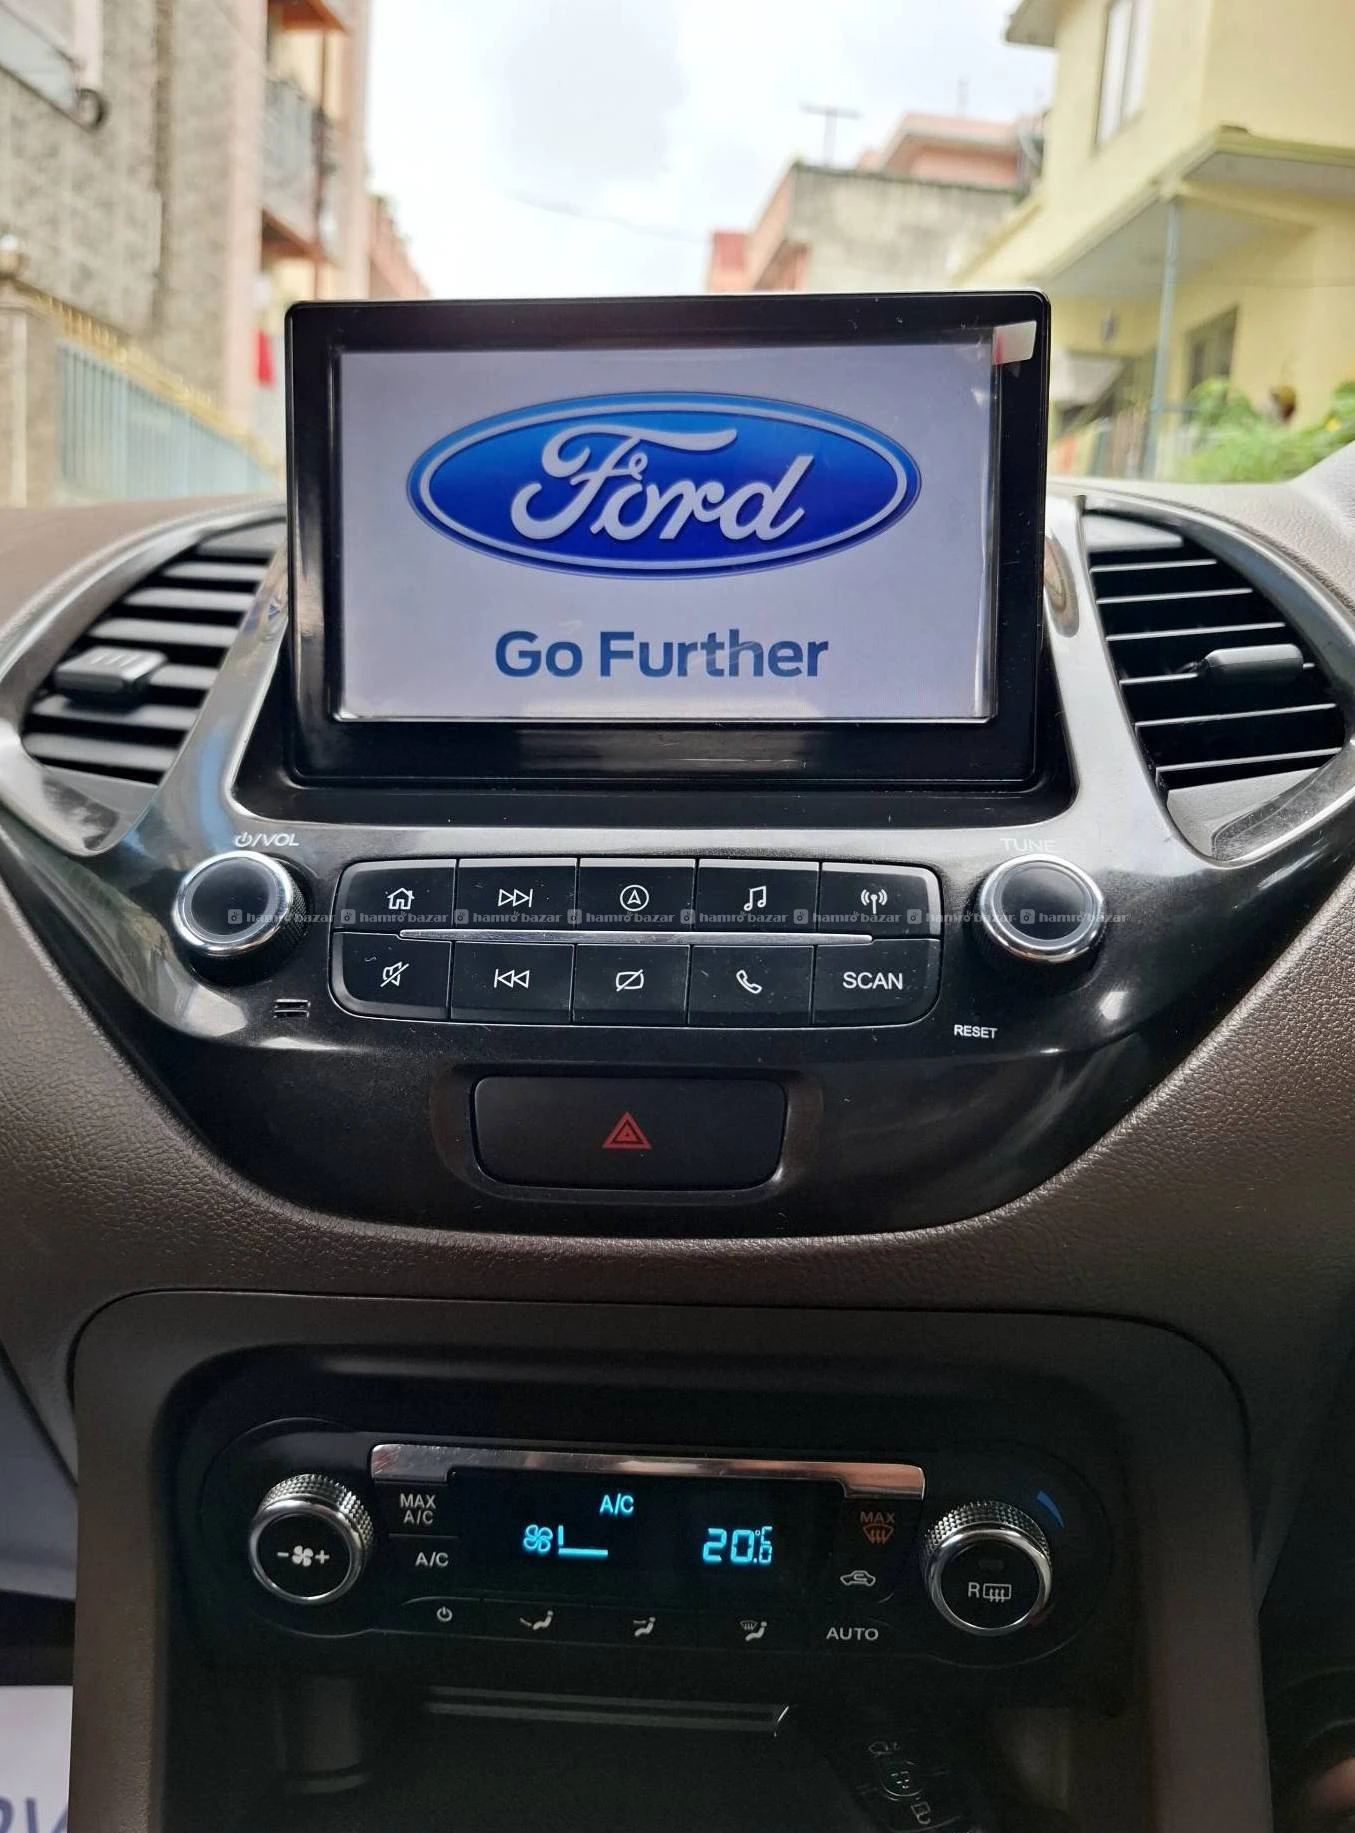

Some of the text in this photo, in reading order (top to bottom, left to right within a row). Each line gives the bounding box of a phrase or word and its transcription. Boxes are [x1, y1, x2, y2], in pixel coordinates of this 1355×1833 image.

[510, 423, 814, 542] Ford
[495, 628, 829, 678] Go Further
[1000, 838, 1057, 852] TUNE
[842, 972, 903, 990] SCAN
[953, 1024, 998, 1039] RESET
[400, 1493, 436, 1509] MAX
[600, 1493, 634, 1515] A/C
[403, 1510, 434, 1525] A/C
[860, 1511, 896, 1524] MAX
[415, 1552, 449, 1567] A/C
[967, 1582, 981, 1598] R
[826, 1627, 879, 1642] AUTO
